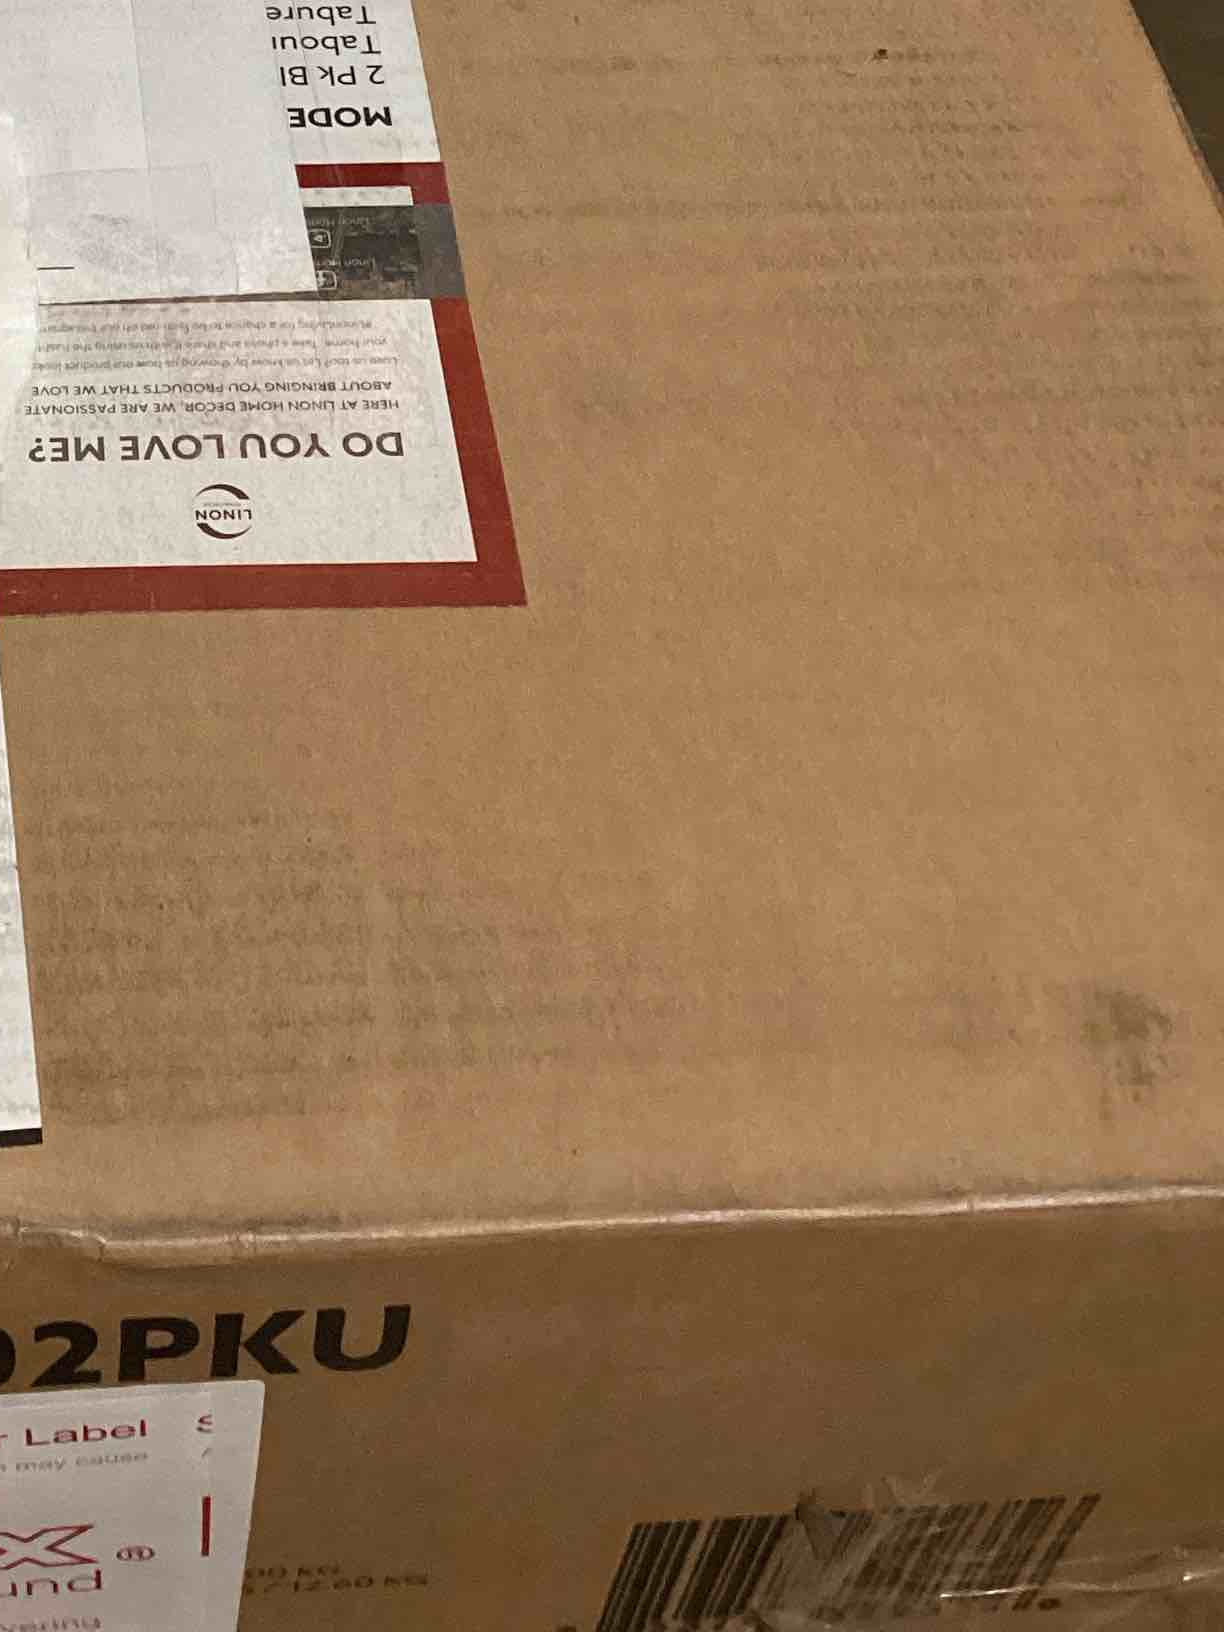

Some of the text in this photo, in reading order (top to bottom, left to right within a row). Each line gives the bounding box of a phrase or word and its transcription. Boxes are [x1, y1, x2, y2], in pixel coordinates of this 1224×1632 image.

[264, 4, 377, 27] Tabure
[316, 65, 357, 87] Pk
[365, 64, 385, 86] 2
[286, 105, 393, 129] MODE
[31, 380, 392, 397] ABOUT BRINGING YOU PRODUCTS THAT WE LOVE
[24, 403, 116, 416] PASSIONATE
[119, 402, 149, 415] ARE
[152, 402, 175, 414] WE
[239, 400, 284, 412] HOME
[287, 400, 335, 412] LINON
[339, 400, 358, 411] AT
[361, 399, 399, 411] HERE
[26, 431, 405, 464] DO YOU LOVE ME?
[194, 509, 253, 521] LINON
[25, 1419, 148, 1448] Label
